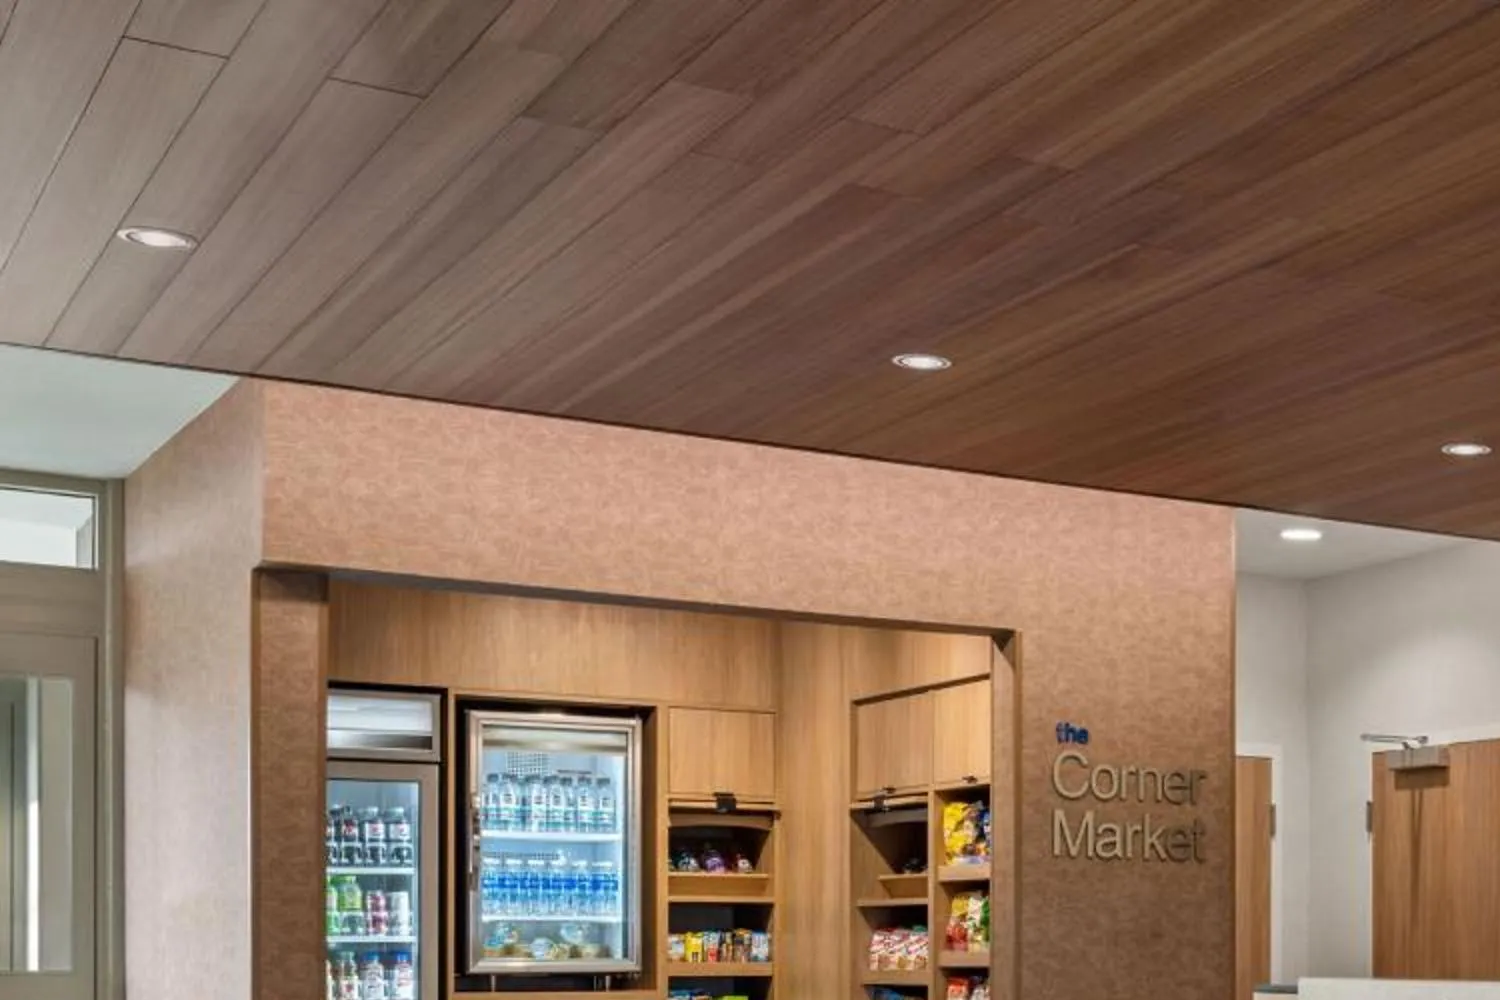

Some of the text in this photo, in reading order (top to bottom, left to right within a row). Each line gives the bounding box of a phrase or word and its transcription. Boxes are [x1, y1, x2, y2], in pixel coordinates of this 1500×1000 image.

[1056, 722, 1088, 744] the
[1053, 752, 1207, 805] Corner
[1053, 808, 1207, 863] Market
